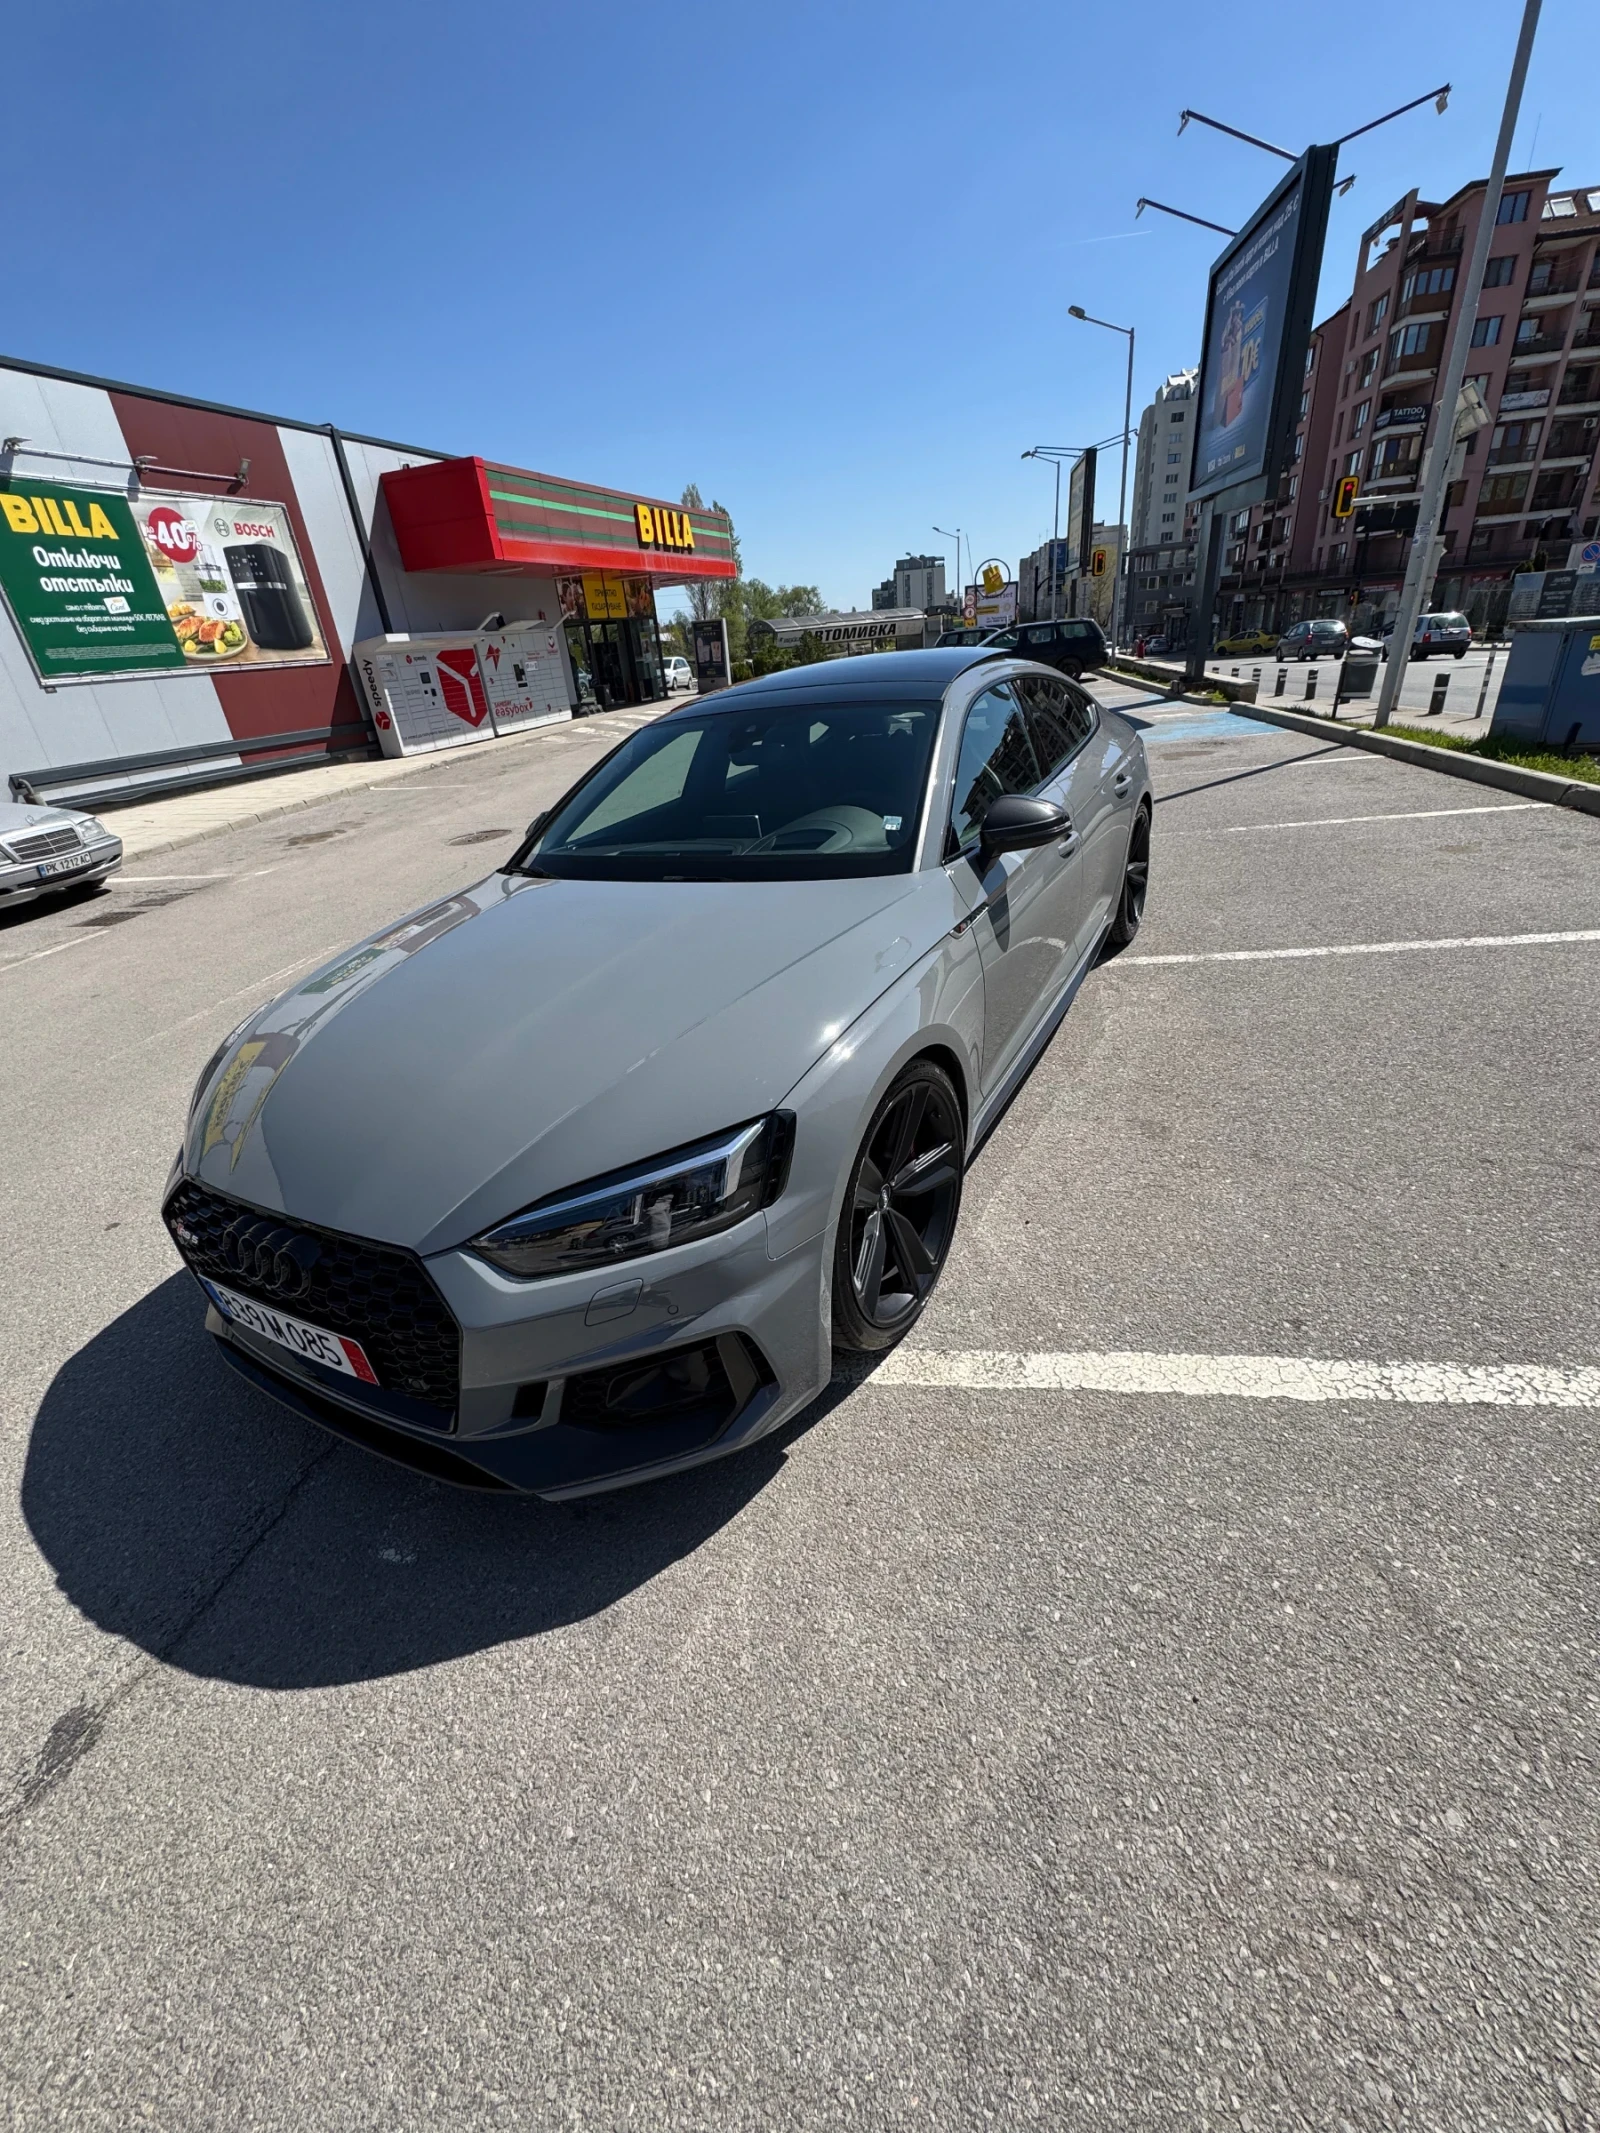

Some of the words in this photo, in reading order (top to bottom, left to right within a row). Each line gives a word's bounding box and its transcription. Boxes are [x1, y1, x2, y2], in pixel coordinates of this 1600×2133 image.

[1394, 406, 1423, 416] TATTOO
[0, 493, 119, 540] BILLA
[635, 504, 695, 548] BILLA
[233, 522, 275, 538] BOSCH
[32, 546, 121, 569] Отключи
[40, 573, 134, 593] отстъпки
[812, 623, 897, 642] ВТОМИВКА
[363, 659, 382, 707] speedy
[495, 703, 530, 718] easybox
[46, 864, 58, 875] PK
[60, 858, 80, 870] 1212
[80, 854, 91, 864] AC
[288, 1325, 343, 1367] 085
